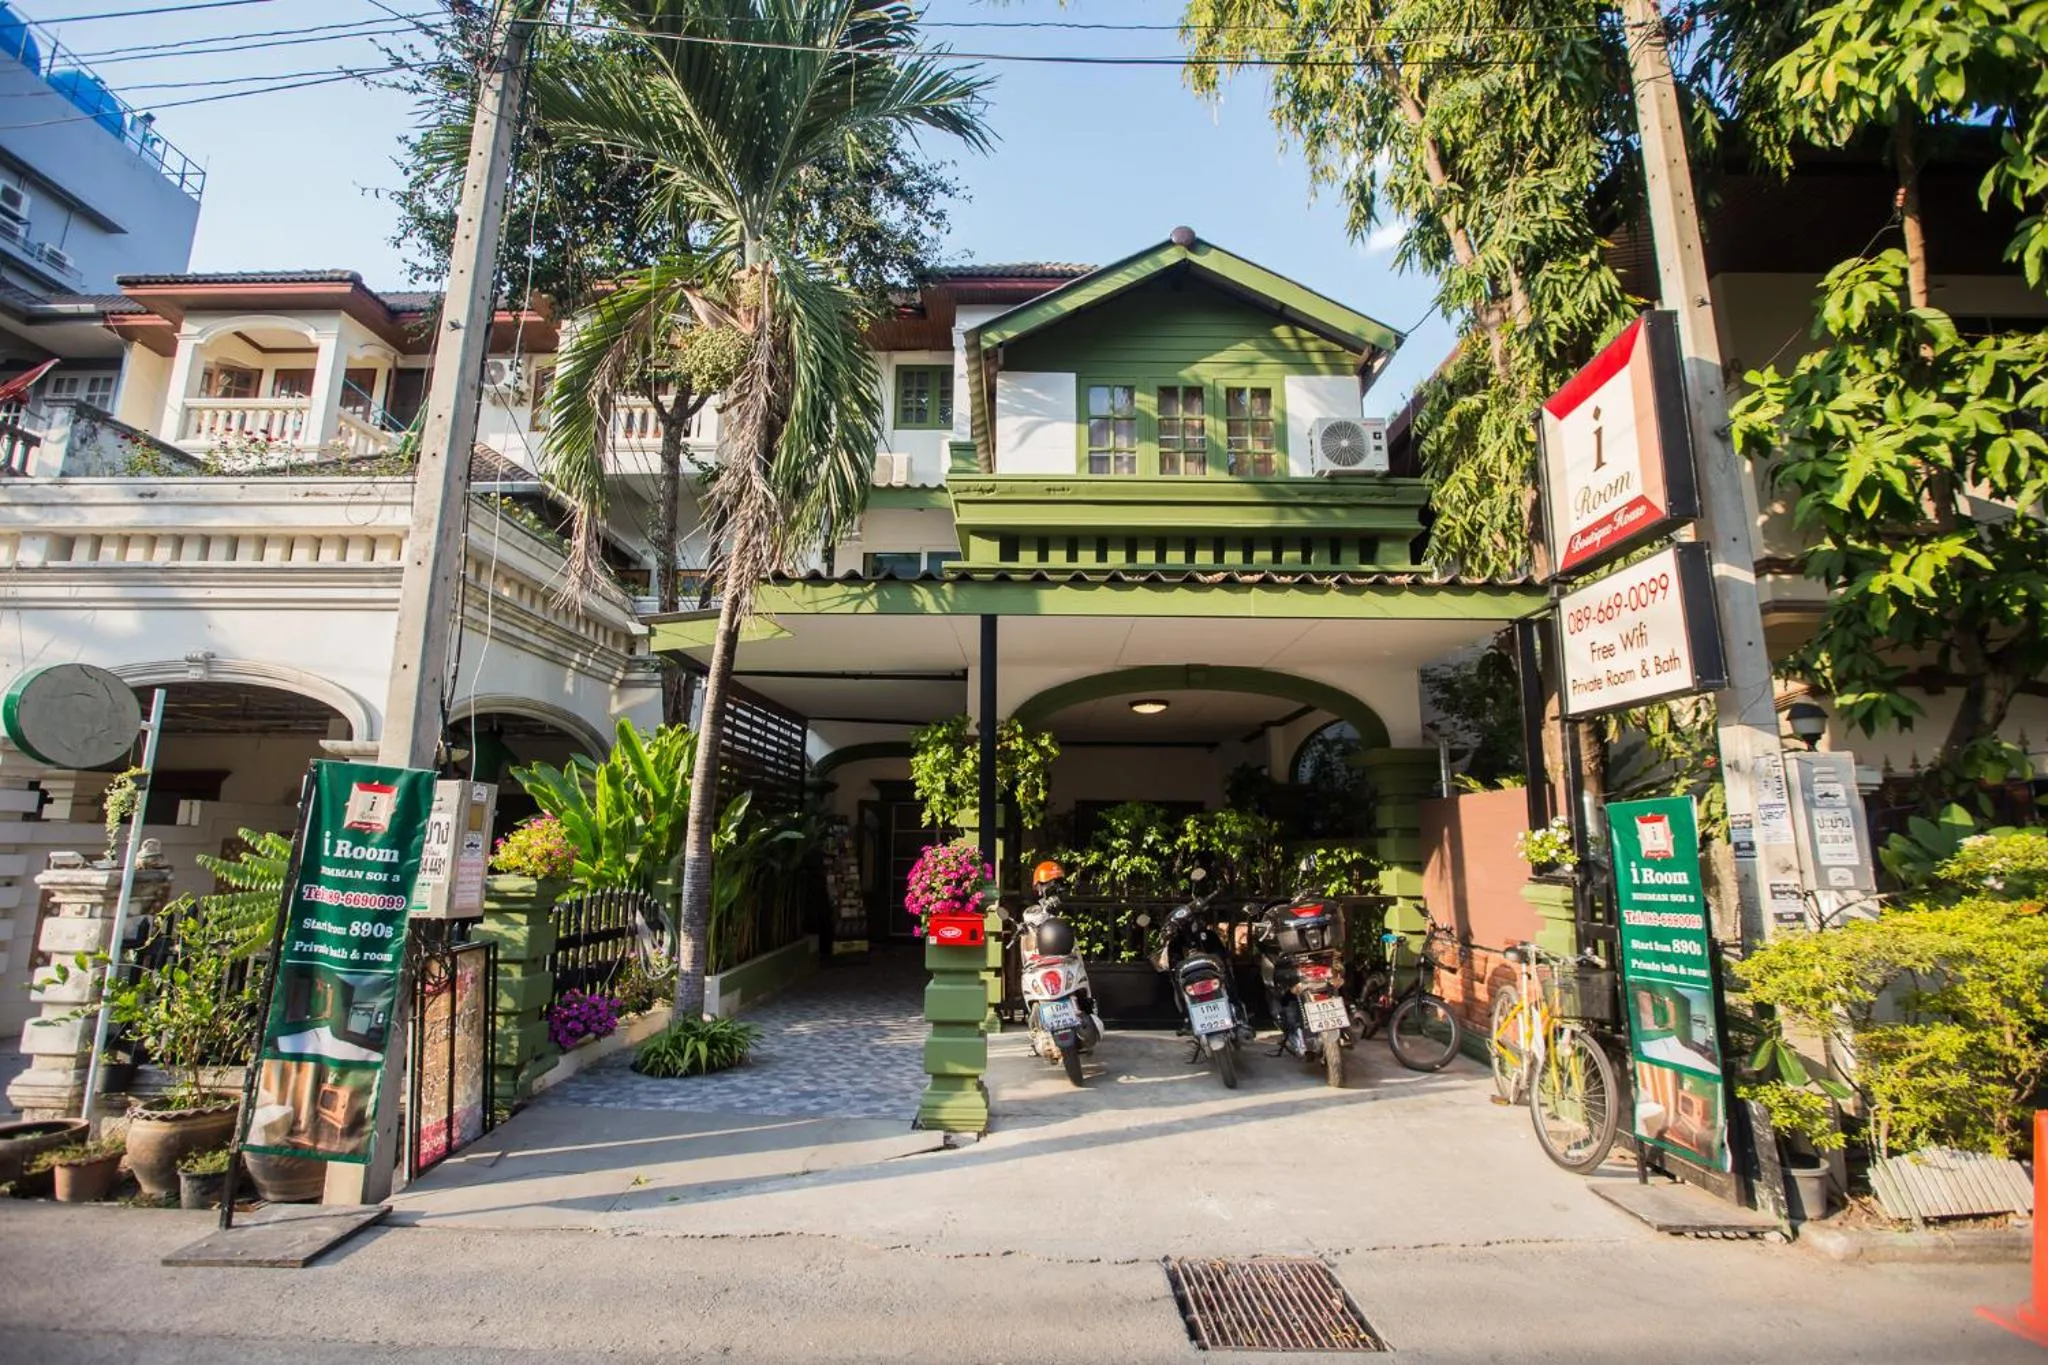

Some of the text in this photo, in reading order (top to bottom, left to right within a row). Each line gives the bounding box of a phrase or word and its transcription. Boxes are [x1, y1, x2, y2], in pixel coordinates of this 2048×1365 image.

[1592, 405, 1607, 472] i
[1574, 470, 1634, 520] Room
[1568, 572, 1669, 635] 089-669-0099
[1590, 621, 1649, 663] Free Wifi
[1572, 648, 1682, 696] Private Room & Bath
[370, 796, 377, 811] i
[323, 830, 400, 863] i Room
[365, 871, 389, 882] SOI
[391, 874, 401, 883] 3
[1630, 861, 1689, 885] i Room
[350, 948, 360, 960] &
[363, 951, 393, 962] room
